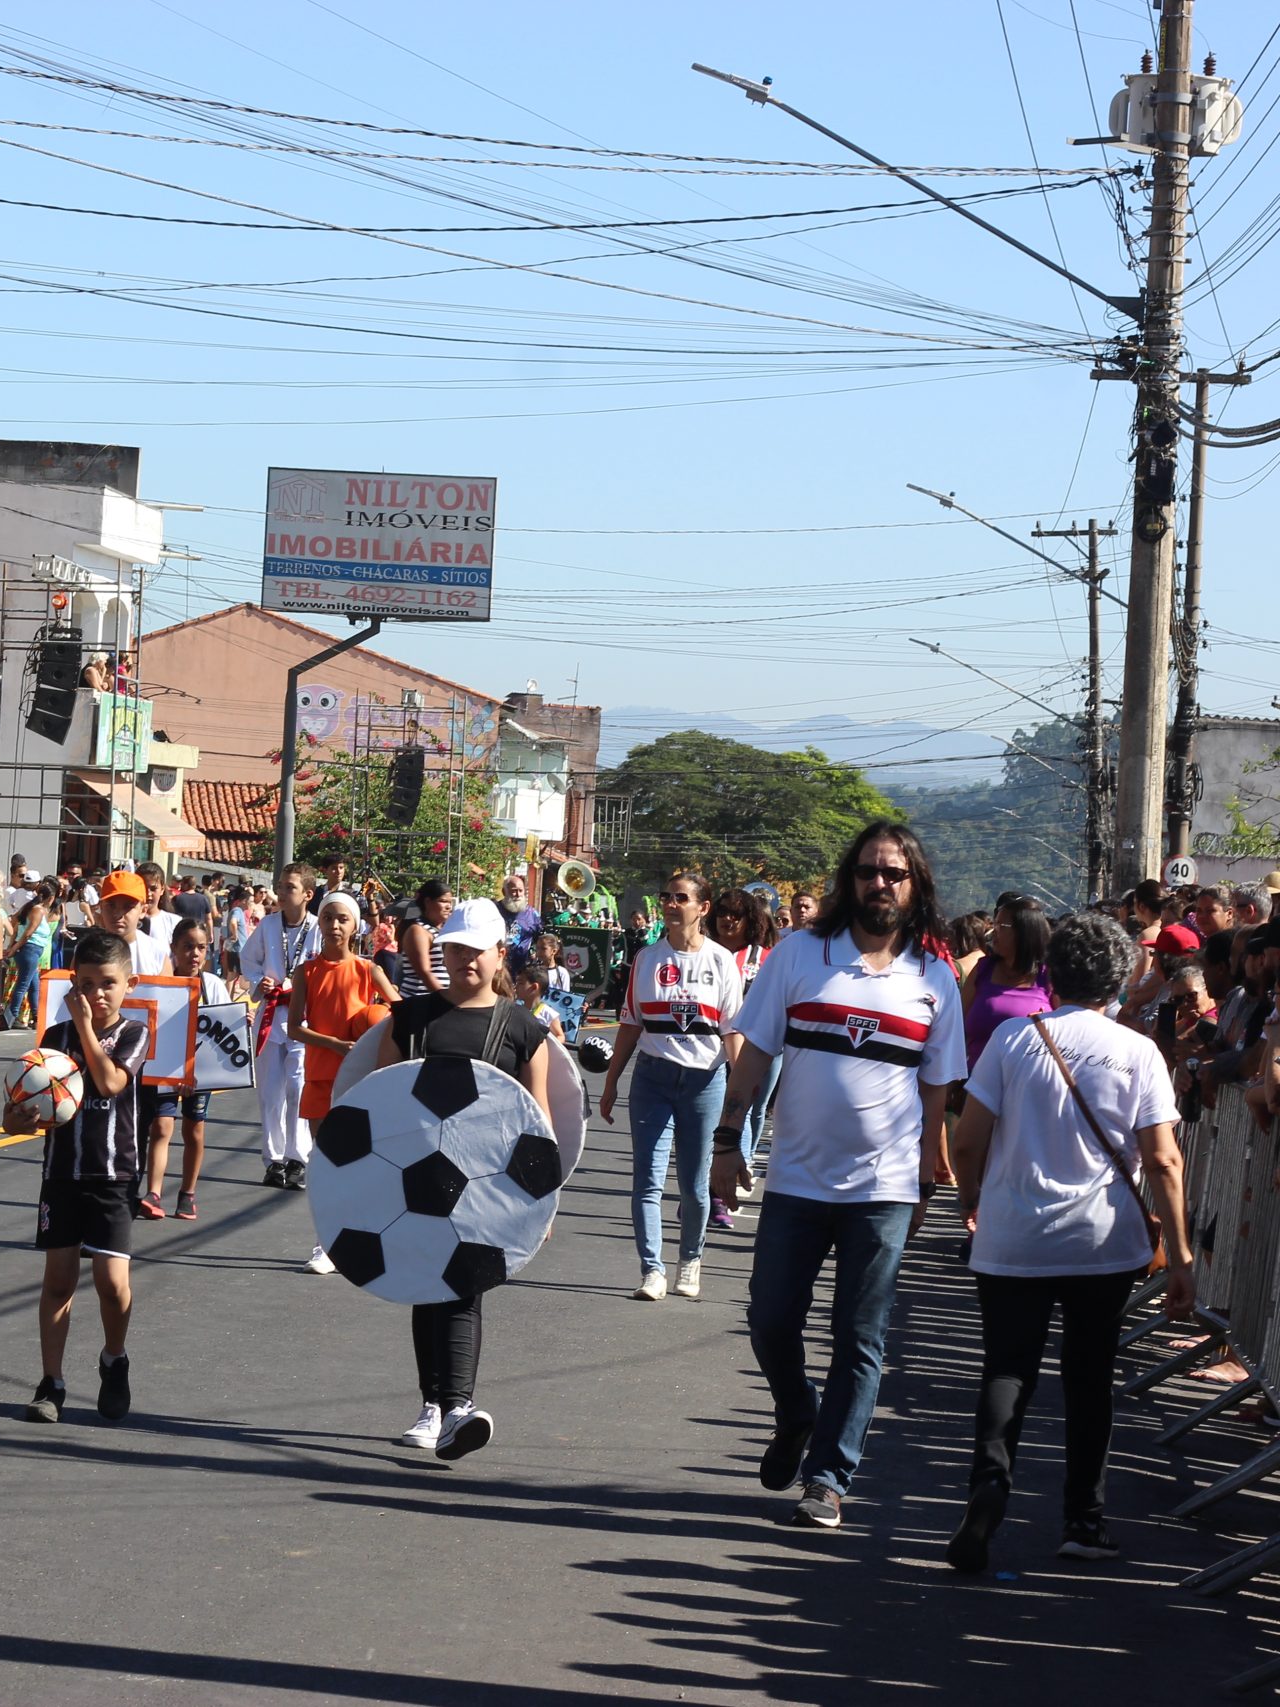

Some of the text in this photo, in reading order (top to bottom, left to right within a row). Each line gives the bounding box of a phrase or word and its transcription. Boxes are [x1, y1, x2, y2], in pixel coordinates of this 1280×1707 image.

[345, 478, 492, 511] NILTON
[345, 510, 492, 532] IMÓVEIS
[267, 533, 489, 565] IMOBILIÁRIA
[267, 560, 341, 576] TERRENOS
[352, 566, 429, 582] CHÁCARAS
[441, 568, 487, 585] SÍTIOS
[275, 580, 477, 608] TEL. 4692-1162
[1171, 863, 1189, 878] 40
[687, 970, 714, 985] LG
[672, 1005, 697, 1013] SPFC
[849, 1017, 876, 1029] SPFC
[197, 1015, 249, 1068] ONDO
